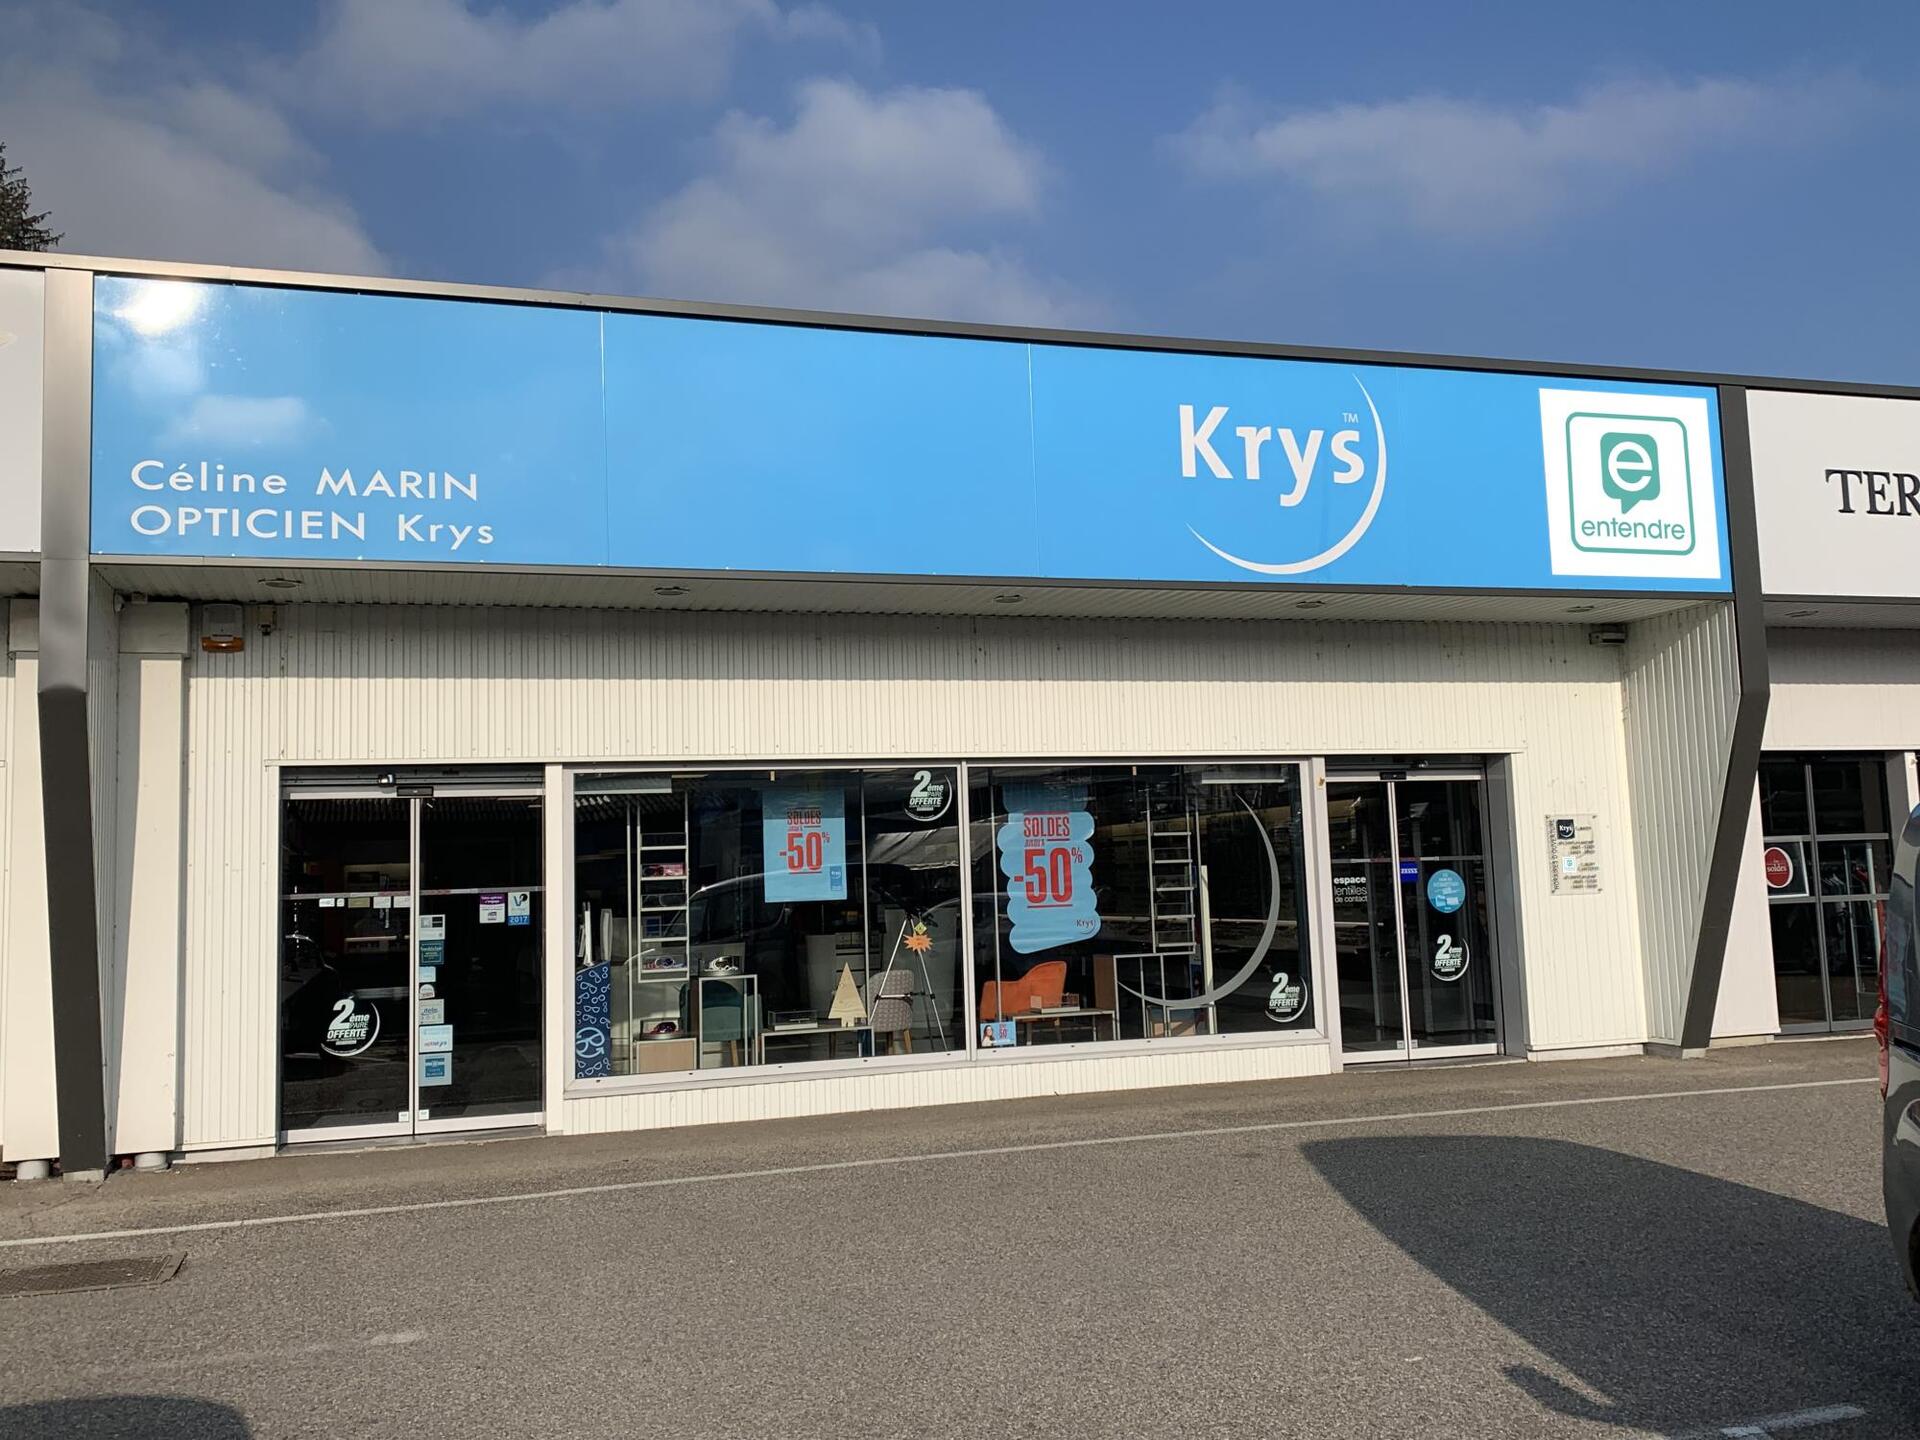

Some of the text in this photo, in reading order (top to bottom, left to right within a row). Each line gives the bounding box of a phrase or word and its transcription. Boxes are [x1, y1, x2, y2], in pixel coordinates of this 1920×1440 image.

[1178, 404, 1365, 507] Krys
[131, 459, 478, 501] Céline MARIN
[1825, 469, 1920, 516] TER
[130, 505, 494, 550] OPTICIEN Krys
[1581, 517, 1686, 541] entendre
[910, 797, 942, 806] OFFERTE
[787, 809, 821, 825] SOLDES
[1024, 816, 1070, 837] SOLDES
[1333, 876, 1367, 886] espace
[1333, 885, 1367, 896] lentilles
[510, 915, 528, 924] 2017
[327, 1029, 367, 1039] OFFERTE
